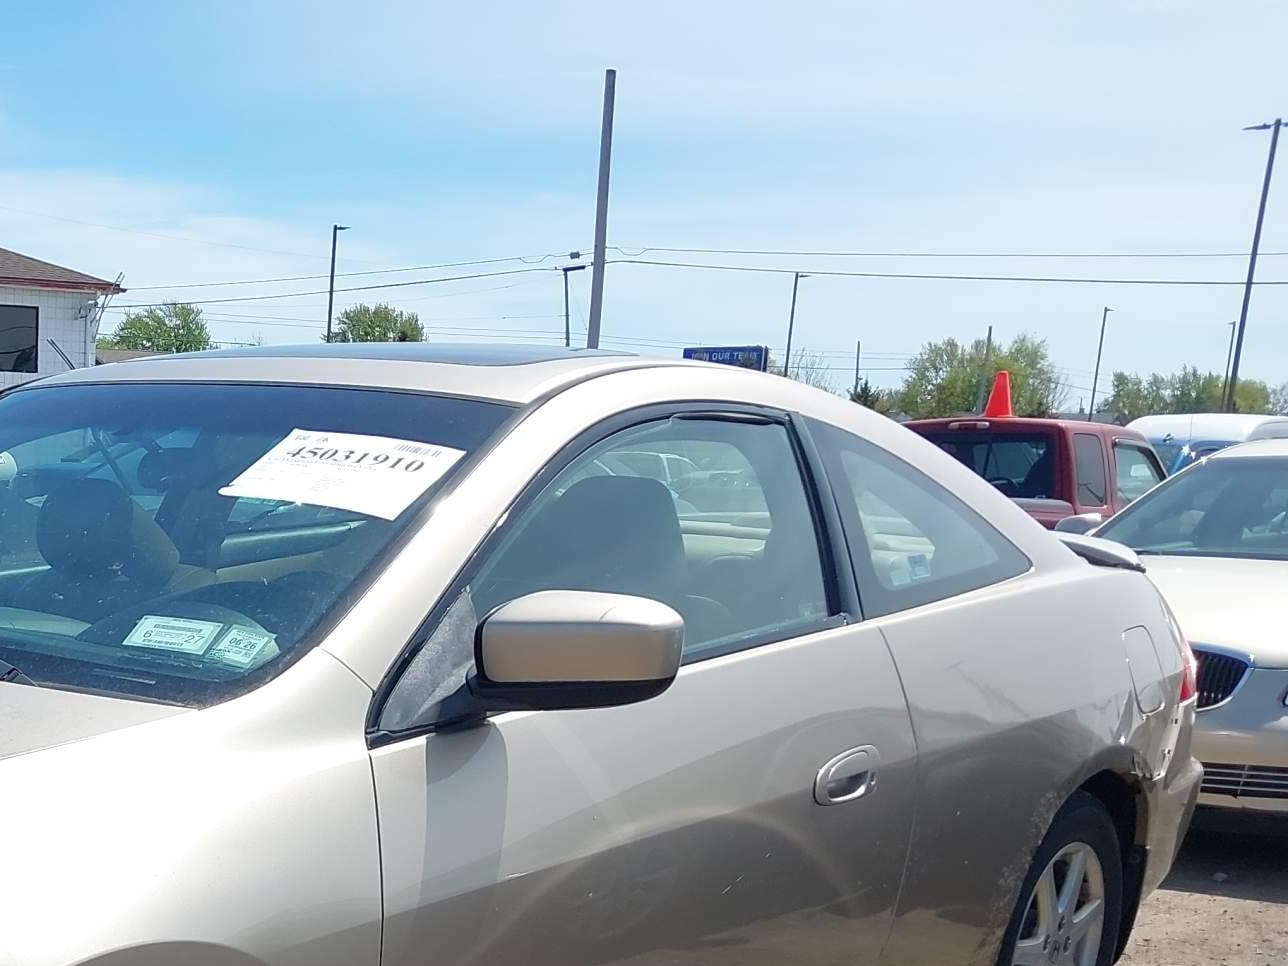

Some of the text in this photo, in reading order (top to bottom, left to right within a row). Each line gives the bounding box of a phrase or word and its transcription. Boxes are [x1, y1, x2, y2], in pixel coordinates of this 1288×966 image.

[712, 352, 730, 360] OUR
[285, 445, 425, 473] 45031910
[143, 630, 152, 638] 6
[184, 634, 205, 645] 27
[228, 636, 258, 650] 06 26
